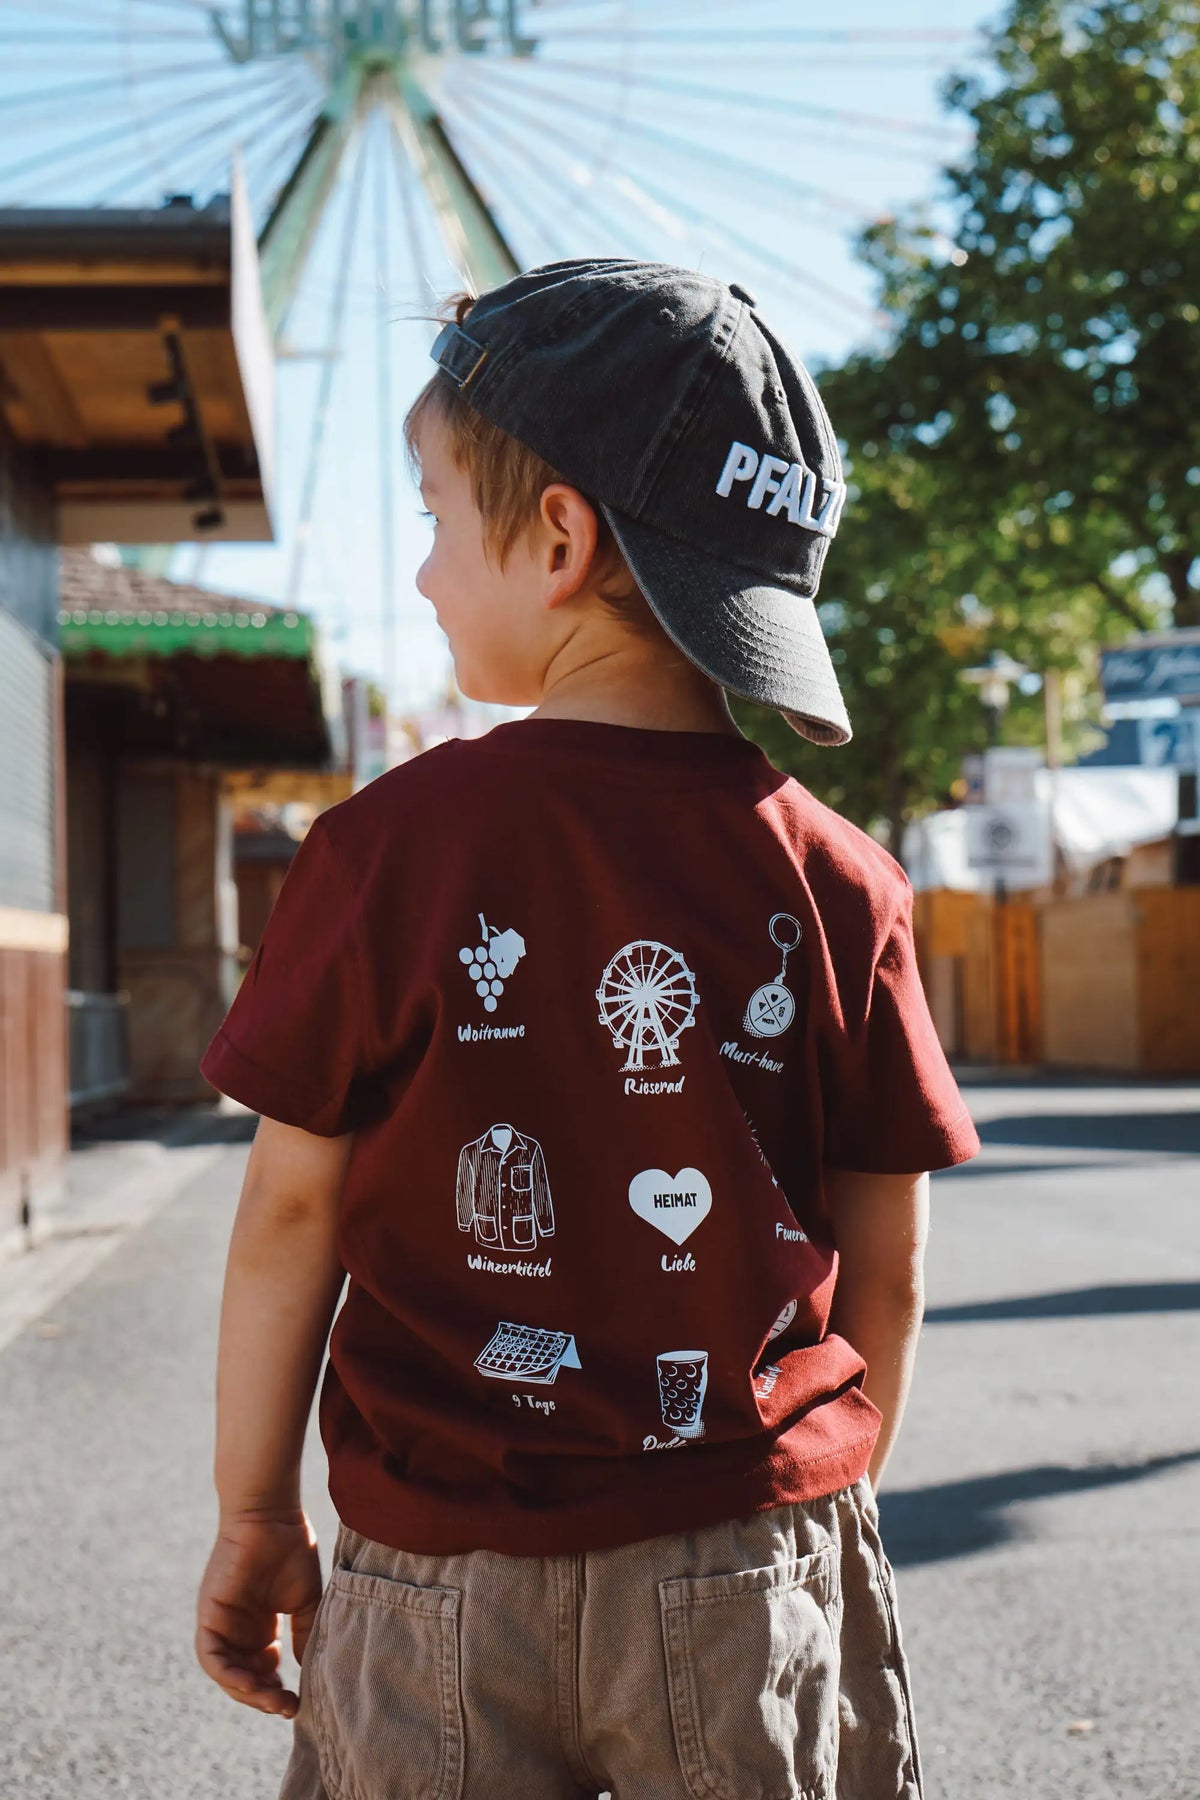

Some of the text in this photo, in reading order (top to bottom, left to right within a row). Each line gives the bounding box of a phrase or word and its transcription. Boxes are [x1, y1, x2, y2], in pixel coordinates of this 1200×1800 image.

[715, 441, 847, 538] PFALZ
[719, 1041, 784, 1073] Must-have
[624, 1075, 685, 1095] Rieserad
[654, 1193, 697, 1209] HEIMAT
[467, 1254, 552, 1278] Winzerkittel
[661, 1253, 696, 1272] Liebe
[512, 1394, 556, 1416] 9 Tage
